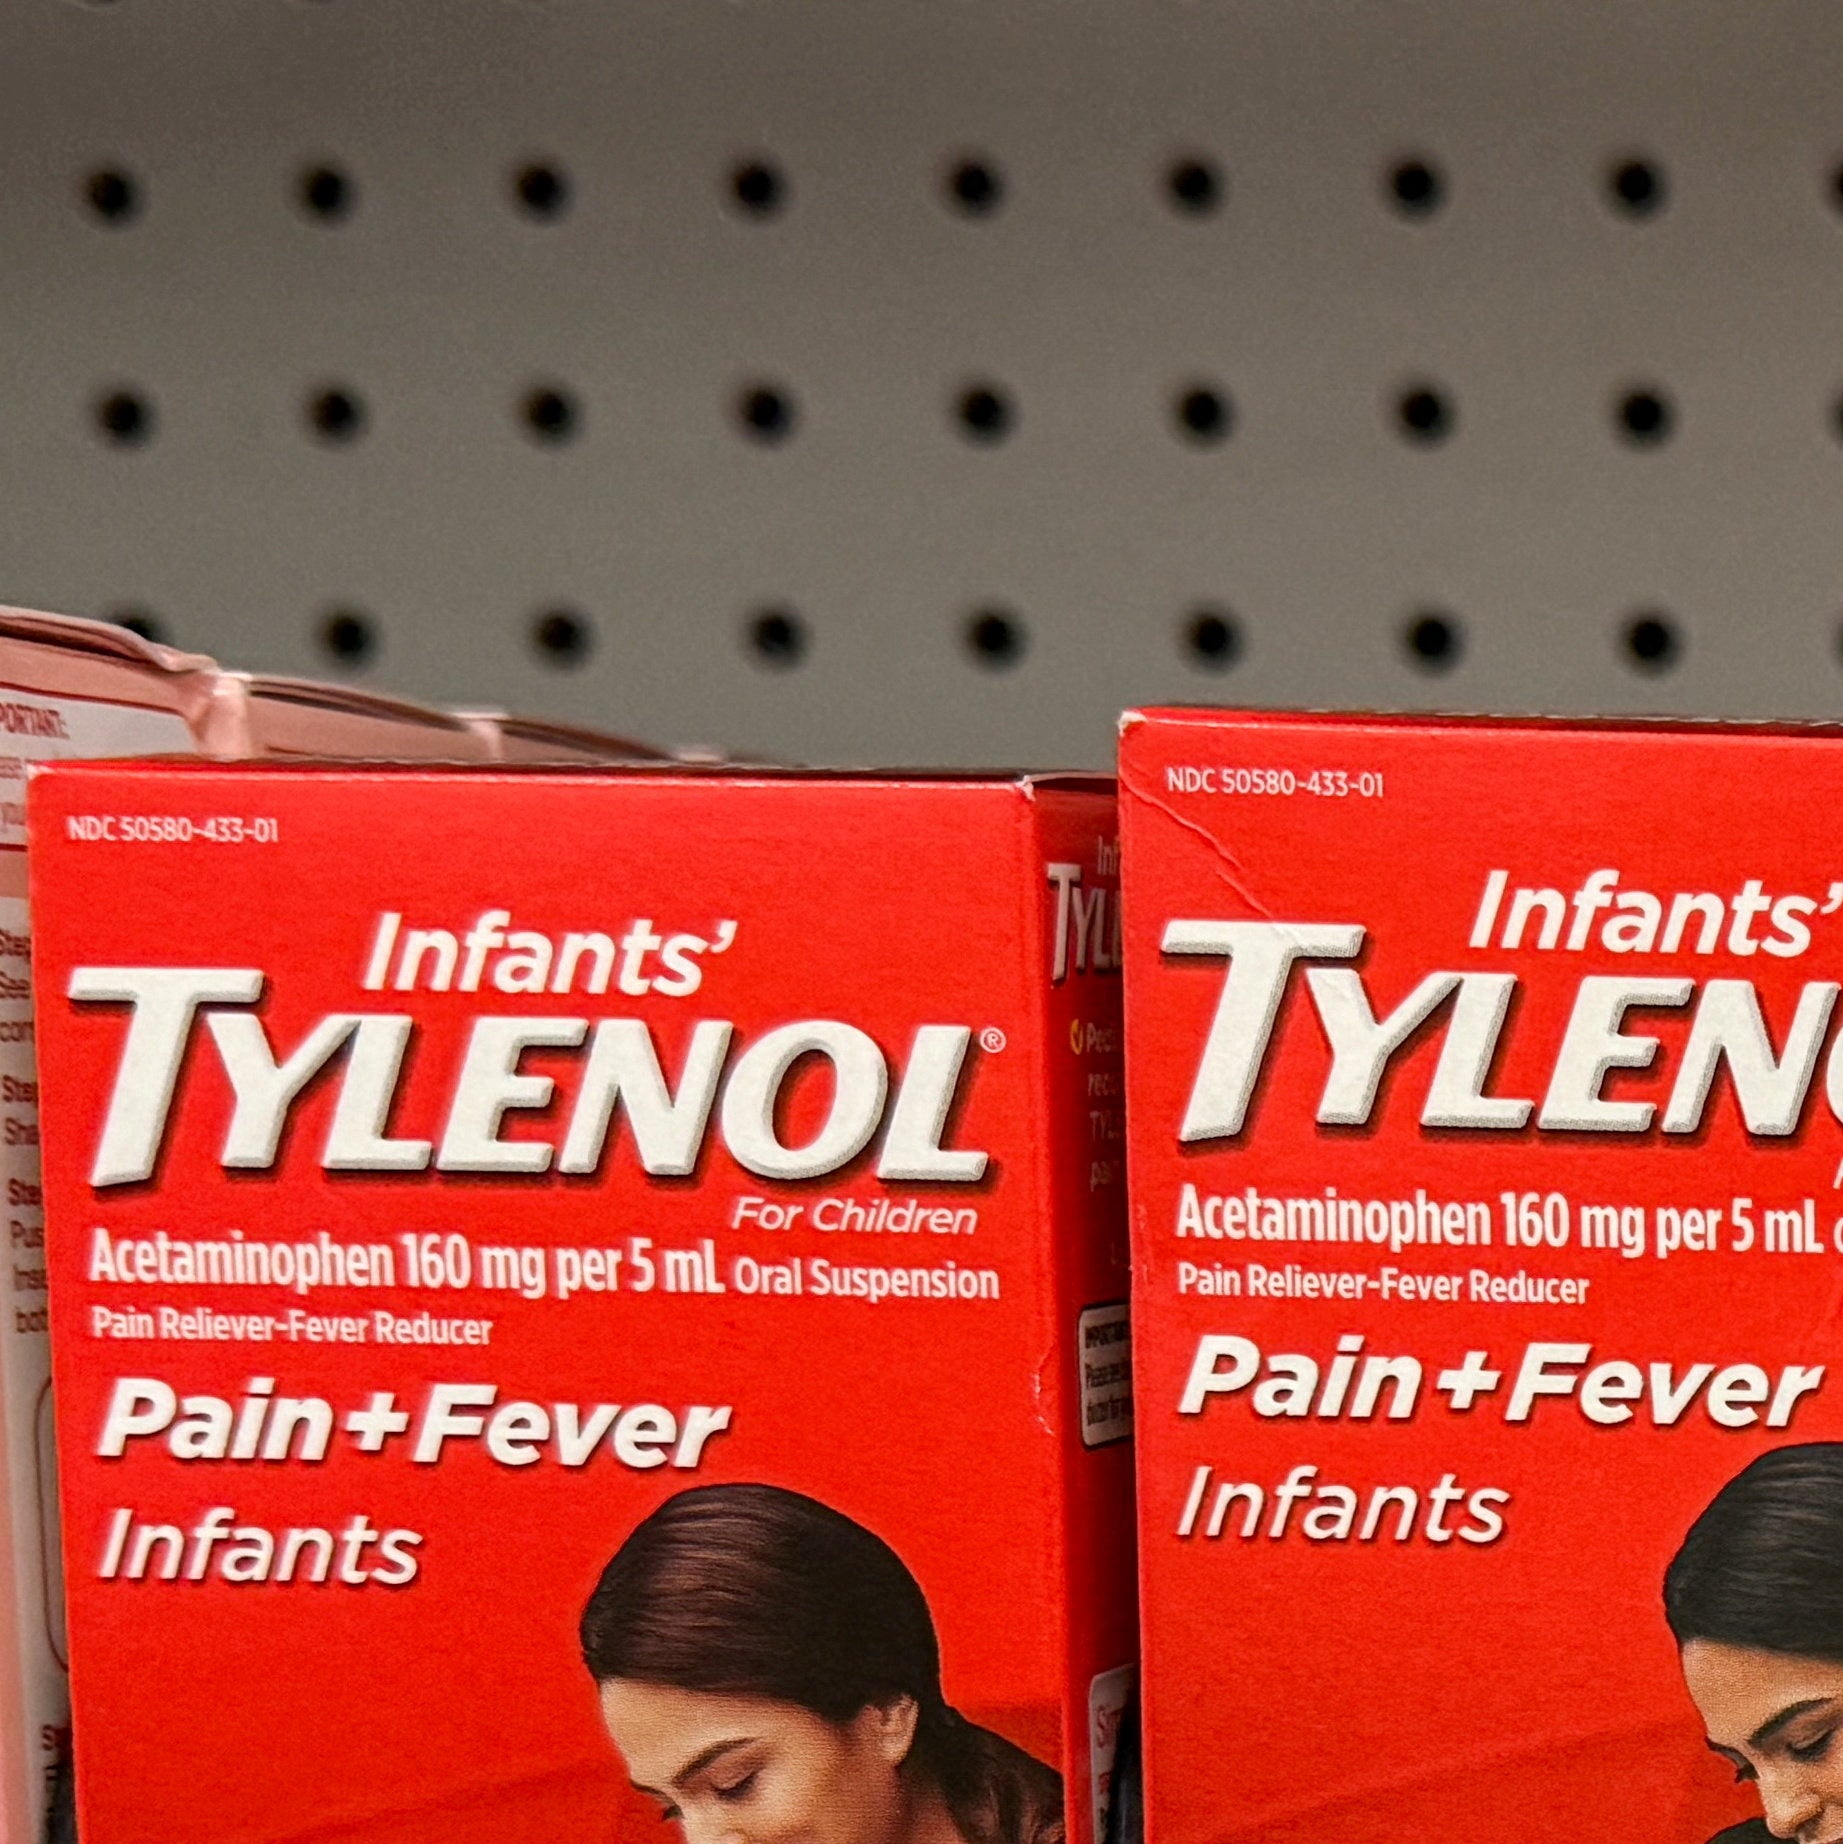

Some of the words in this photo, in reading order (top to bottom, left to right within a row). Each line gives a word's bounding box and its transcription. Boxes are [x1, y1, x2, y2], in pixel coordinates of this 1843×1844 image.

[1178, 1261, 1240, 1296] Pain
[1247, 1263, 1463, 1301] Reliever-Fever
[1470, 1269, 1589, 1304] Reducer
[1177, 1464, 1509, 1544] Infants
[98, 1507, 423, 1586] Infants
